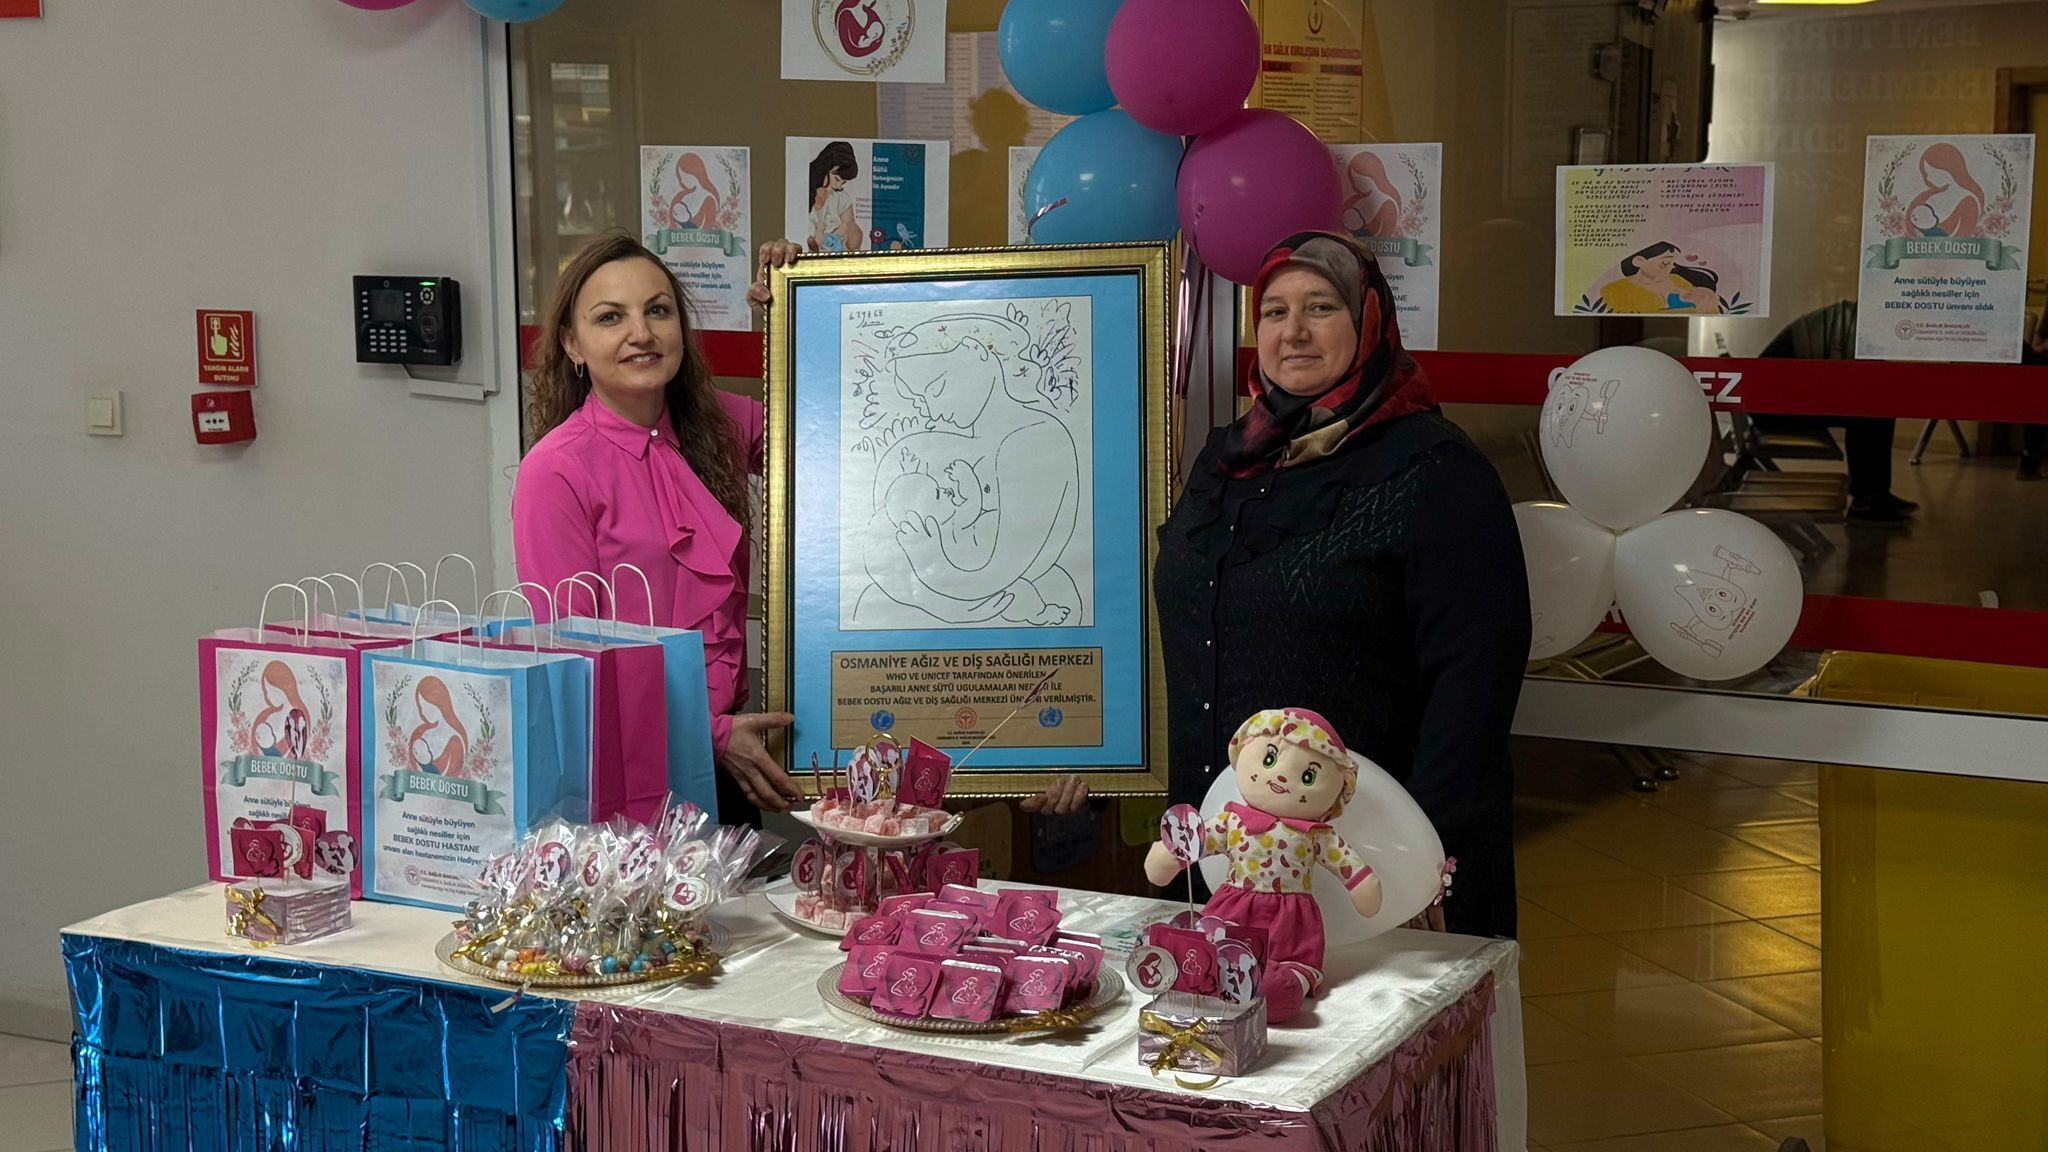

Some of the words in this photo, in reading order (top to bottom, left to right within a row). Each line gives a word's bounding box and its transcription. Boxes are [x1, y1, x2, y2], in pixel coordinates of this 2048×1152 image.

[671, 232, 694, 243] BEBEK
[696, 233, 720, 244] DOSTU
[1371, 241, 1400, 253] DOSTU
[1907, 242, 1941, 255] BEBEK
[1945, 243, 1980, 255] DOSTU
[1894, 277, 1915, 285] Anne
[1917, 277, 1948, 287] sütüyle
[1950, 277, 1986, 287] büyüyen
[1901, 290, 1930, 299] sağlıklı
[1964, 291, 1980, 299] için
[1915, 302, 1944, 310] DOSTU
[1975, 303, 1994, 311] aldık
[203, 364, 227, 372] YANGIN
[228, 364, 249, 372] ALARM
[214, 374, 239, 382] BUTONU
[840, 655, 907, 669] OSMANİYE
[911, 654, 939, 668] AĞIZ
[943, 657, 959, 667] VE
[963, 654, 982, 670] DİŞ
[986, 653, 1034, 667] SAĞLIĞI
[1039, 652, 1094, 666] MERKEZİ
[886, 672, 907, 681] WHO
[909, 672, 919, 680] VE
[921, 672, 951, 680] UNICEF
[952, 671, 1004, 679] TARAFINDAN
[1006, 670, 1046, 679] ÖNERİLEN
[870, 685, 905, 694] BAŞARILI
[907, 685, 931, 693] ANNE
[932, 683, 954, 693] SÜTÜ
[956, 683, 1016, 692] UGULAMALARI
[1051, 681, 1062, 690] İLE
[837, 698, 861, 706] BEBEK
[893, 696, 912, 705] AĞIZ
[925, 696, 938, 706] DİŞ
[940, 695, 972, 705] SAĞLIĞI
[974, 694, 1008, 704] MERKEZİ
[1043, 694, 1096, 705] VERİLMİŞTİR.
[251, 760, 277, 774] BEBEK
[280, 762, 307, 778] DOSTU
[409, 775, 436, 792] BEBEK
[439, 781, 468, 797] DOSTU
[244, 795, 259, 804] Anne
[260, 797, 283, 807] sütüyle
[248, 810, 270, 819] sağlıklı
[402, 811, 417, 821] Anne
[418, 814, 442, 826] sütüyle
[444, 818, 475, 829] büyüyen
[407, 826, 428, 836] sağlıklı
[429, 828, 455, 839] nesiller
[457, 831, 470, 841] için
[393, 834, 414, 845] BEBEK
[415, 838, 440, 849] DOSTU
[441, 841, 480, 853] HASTANE
[402, 847, 414, 856] alan
[415, 850, 456, 861] hastanemizin
